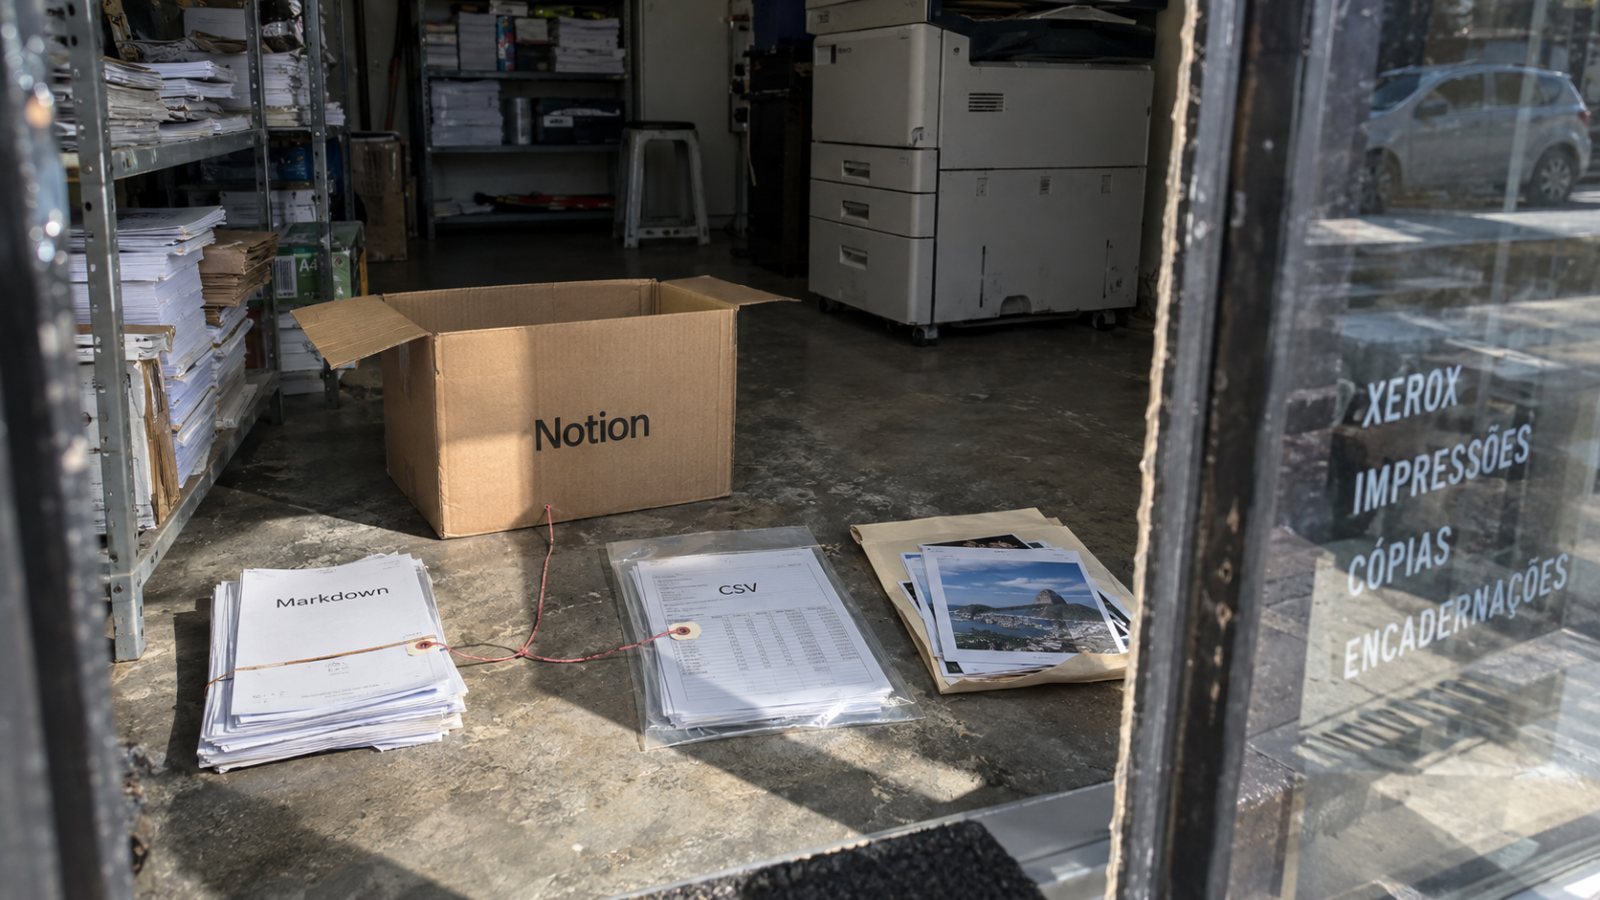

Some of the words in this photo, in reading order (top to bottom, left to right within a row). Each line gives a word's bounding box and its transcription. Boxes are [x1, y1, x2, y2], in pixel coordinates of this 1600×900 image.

[299, 259, 317, 272] A4
[1362, 365, 1462, 428] XEROX
[535, 411, 649, 451] Notion
[1353, 424, 1531, 515] IMPRESSÕES
[1348, 526, 1451, 596] CÓPIAS
[277, 586, 389, 608] Markdown
[719, 582, 757, 595] CSV
[1344, 553, 1568, 680] ENCADERNAÇÕES
